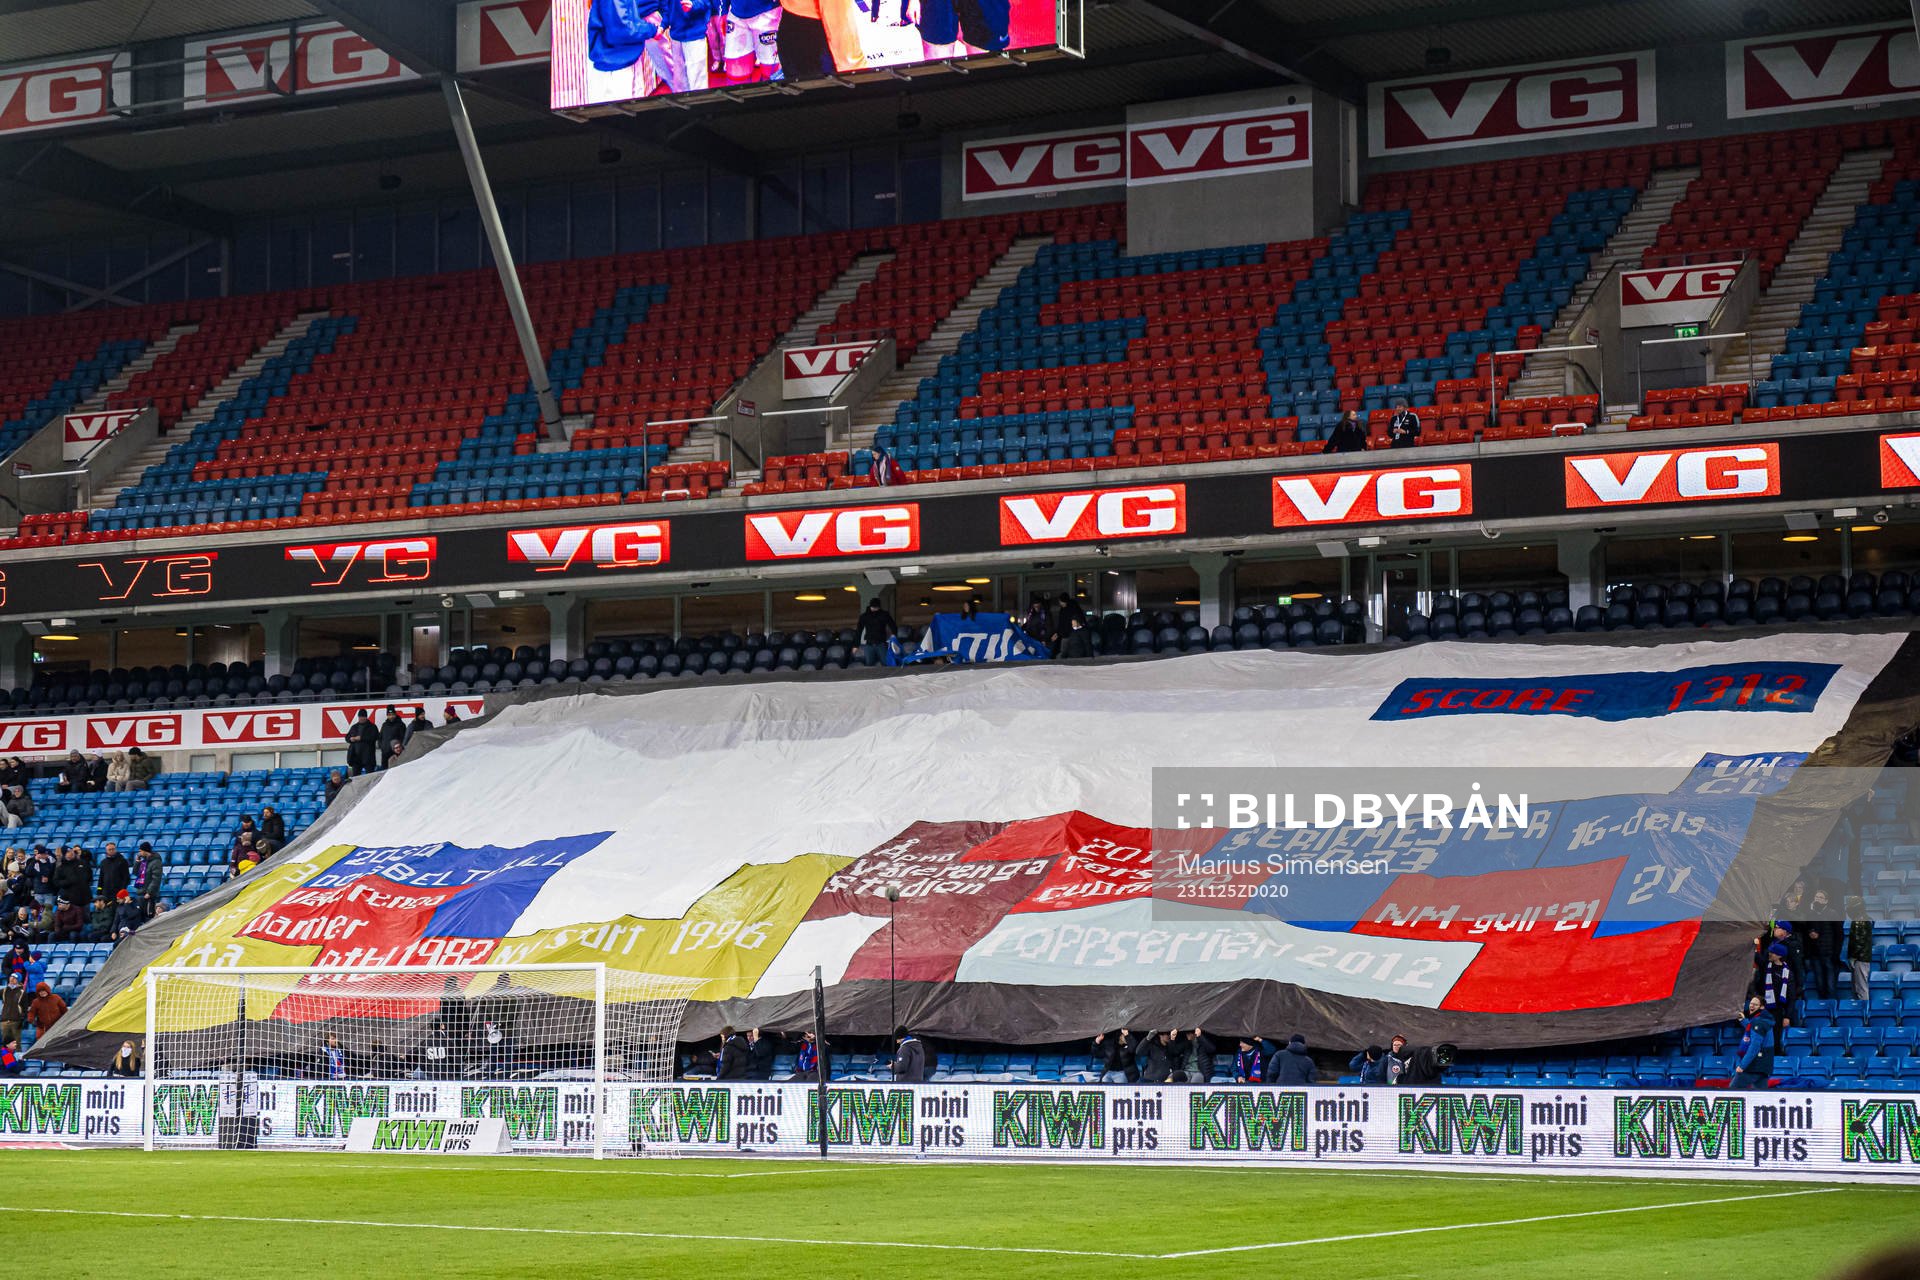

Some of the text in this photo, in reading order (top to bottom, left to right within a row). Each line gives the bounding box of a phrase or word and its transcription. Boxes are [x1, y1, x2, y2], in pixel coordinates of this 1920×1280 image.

[211, 31, 390, 90] VG
[1751, 32, 1920, 99] V
[0, 67, 102, 122] G
[1392, 66, 1623, 140] VG
[972, 137, 1122, 186] VG
[1135, 118, 1297, 171] VG
[1626, 268, 1739, 300] VG
[789, 347, 876, 375] VG
[1569, 447, 1769, 502] VG
[1003, 488, 1176, 540] VG
[1276, 468, 1463, 522] VG
[511, 525, 662, 571] VG
[750, 507, 911, 556] VG
[78, 556, 212, 600] VG
[288, 540, 430, 586] VG
[1402, 673, 1807, 713] SCORE 1312
[90, 718, 175, 746] VG
[207, 712, 294, 740] VG
[1567, 806, 1706, 850] 16-dels
[850, 858, 1049, 882] Vålerenga
[1627, 864, 1691, 905] 21
[243, 911, 369, 941] Damer
[670, 920, 774, 954] 1996
[1296, 944, 1443, 988] 2012
[86, 1085, 125, 1110] mini
[395, 1086, 437, 1112] mini
[461, 1086, 557, 1141] KIWI
[629, 1088, 731, 1143] KIWI
[736, 1088, 782, 1116] mini
[921, 1090, 968, 1118] mini
[1113, 1091, 1162, 1120] mini
[1315, 1092, 1369, 1122] mini
[1530, 1095, 1588, 1126] mini
[1754, 1097, 1813, 1129] mini
[85, 1110, 121, 1140] pris
[372, 1119, 447, 1150] KIWI
[448, 1120, 480, 1135] mini
[736, 1117, 778, 1149] pris
[806, 1088, 914, 1146] KIWI
[921, 1118, 964, 1151] pris
[993, 1090, 1106, 1149] KIWI
[1189, 1092, 1308, 1152] KIWI
[1399, 1093, 1523, 1155] KIWI
[1614, 1095, 1745, 1160] KIWI
[444, 1136, 472, 1153] pris
[1113, 1120, 1158, 1155] pris
[1315, 1122, 1365, 1158] pris
[1531, 1126, 1582, 1162] pris
[1754, 1129, 1809, 1167] pris
